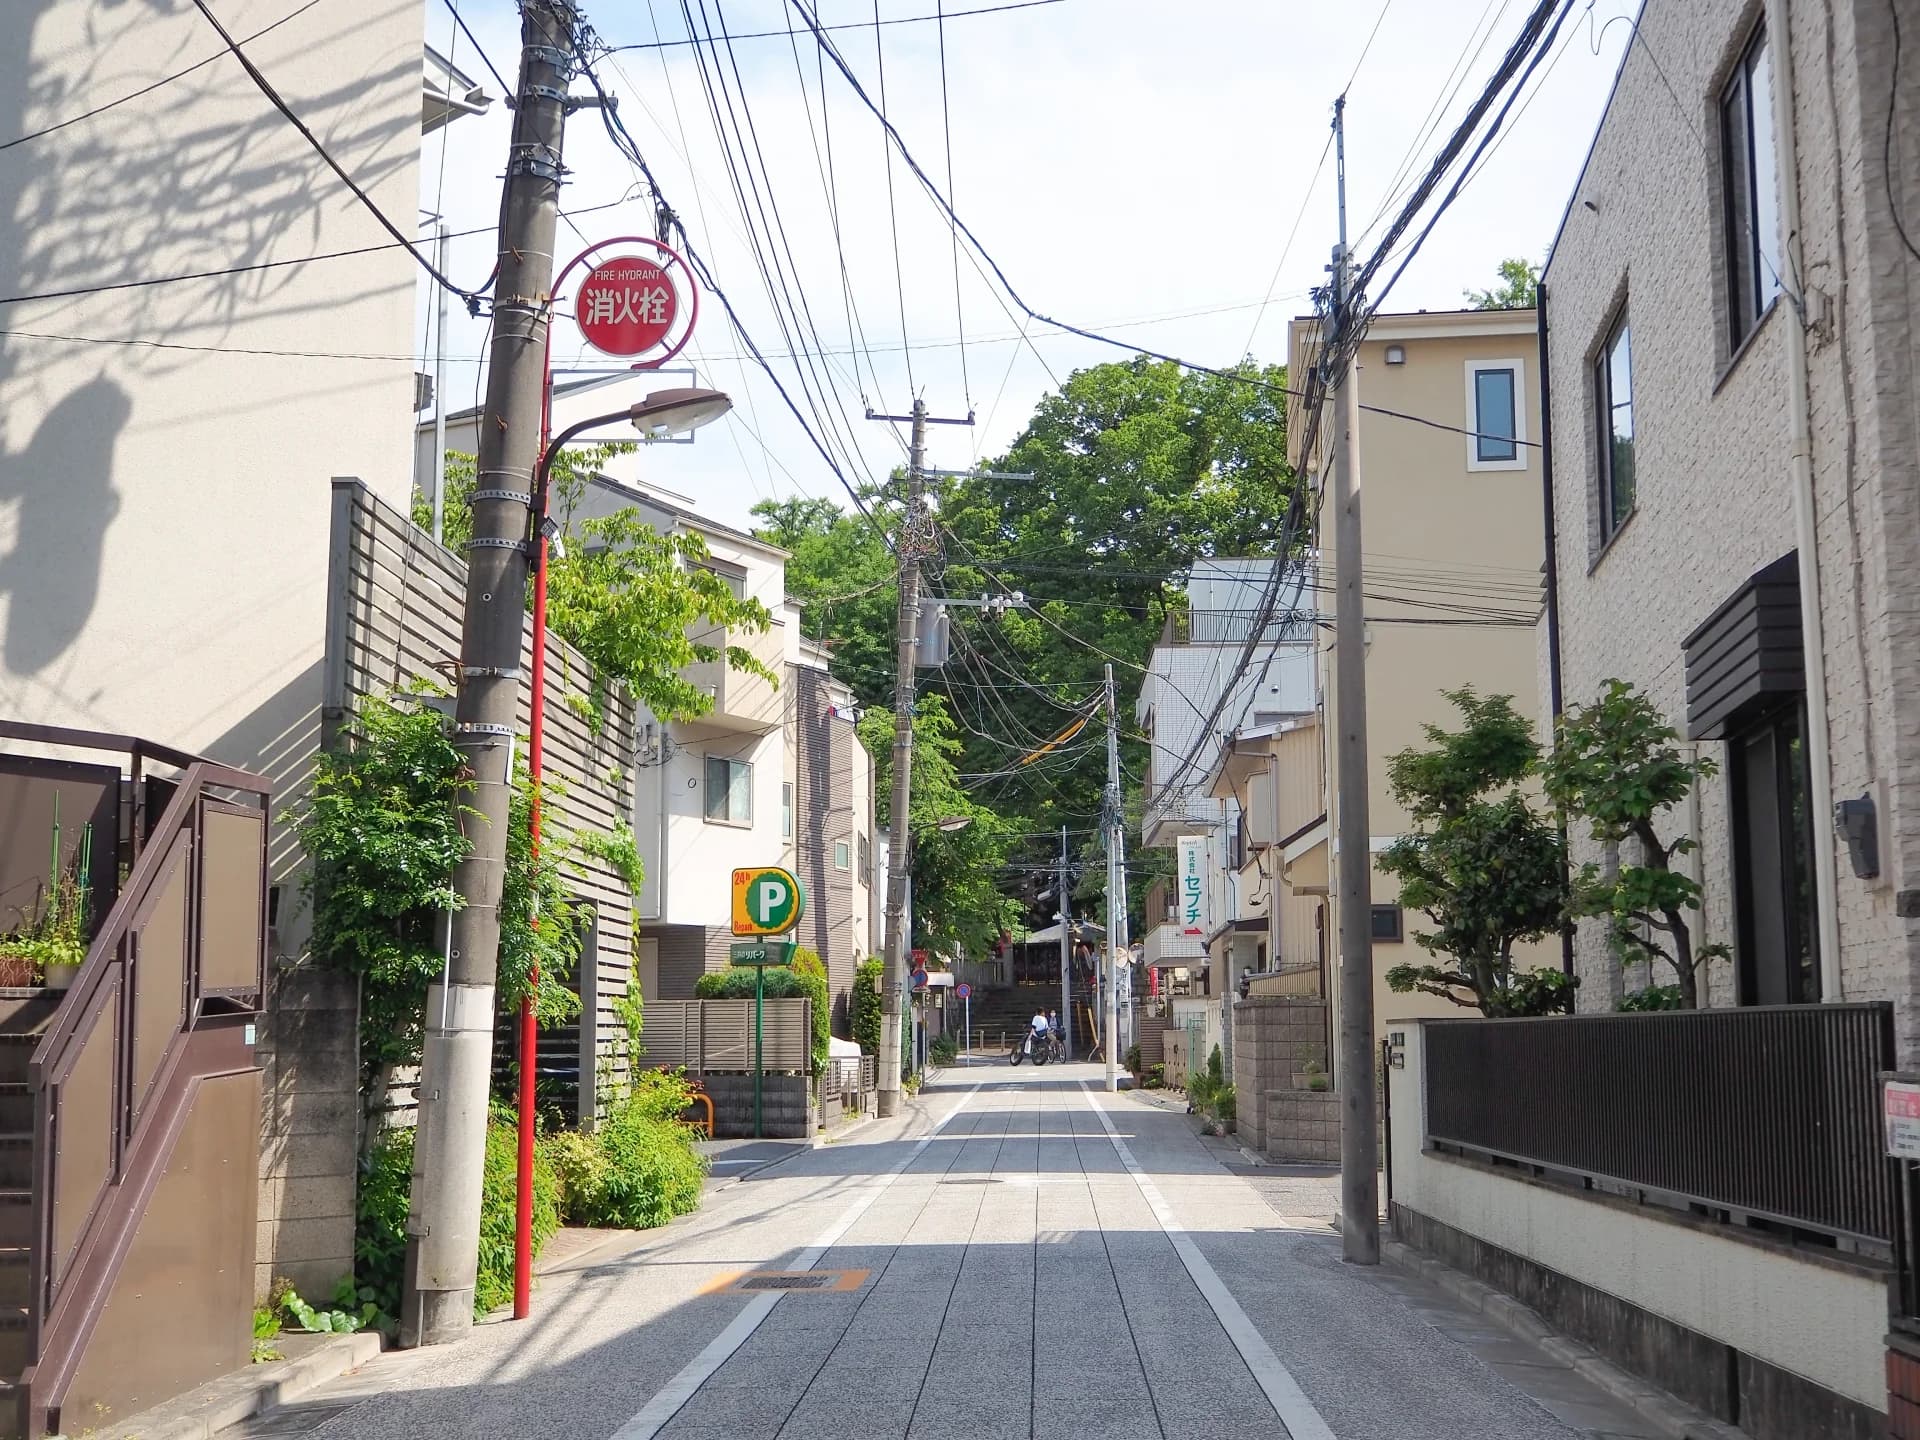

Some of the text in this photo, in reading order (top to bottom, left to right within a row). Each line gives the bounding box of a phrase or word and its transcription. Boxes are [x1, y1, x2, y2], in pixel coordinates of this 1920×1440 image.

[594, 269, 661, 281] FIRE HYDRANT
[585, 286, 669, 326] 消火栓
[759, 881, 787, 922] P
